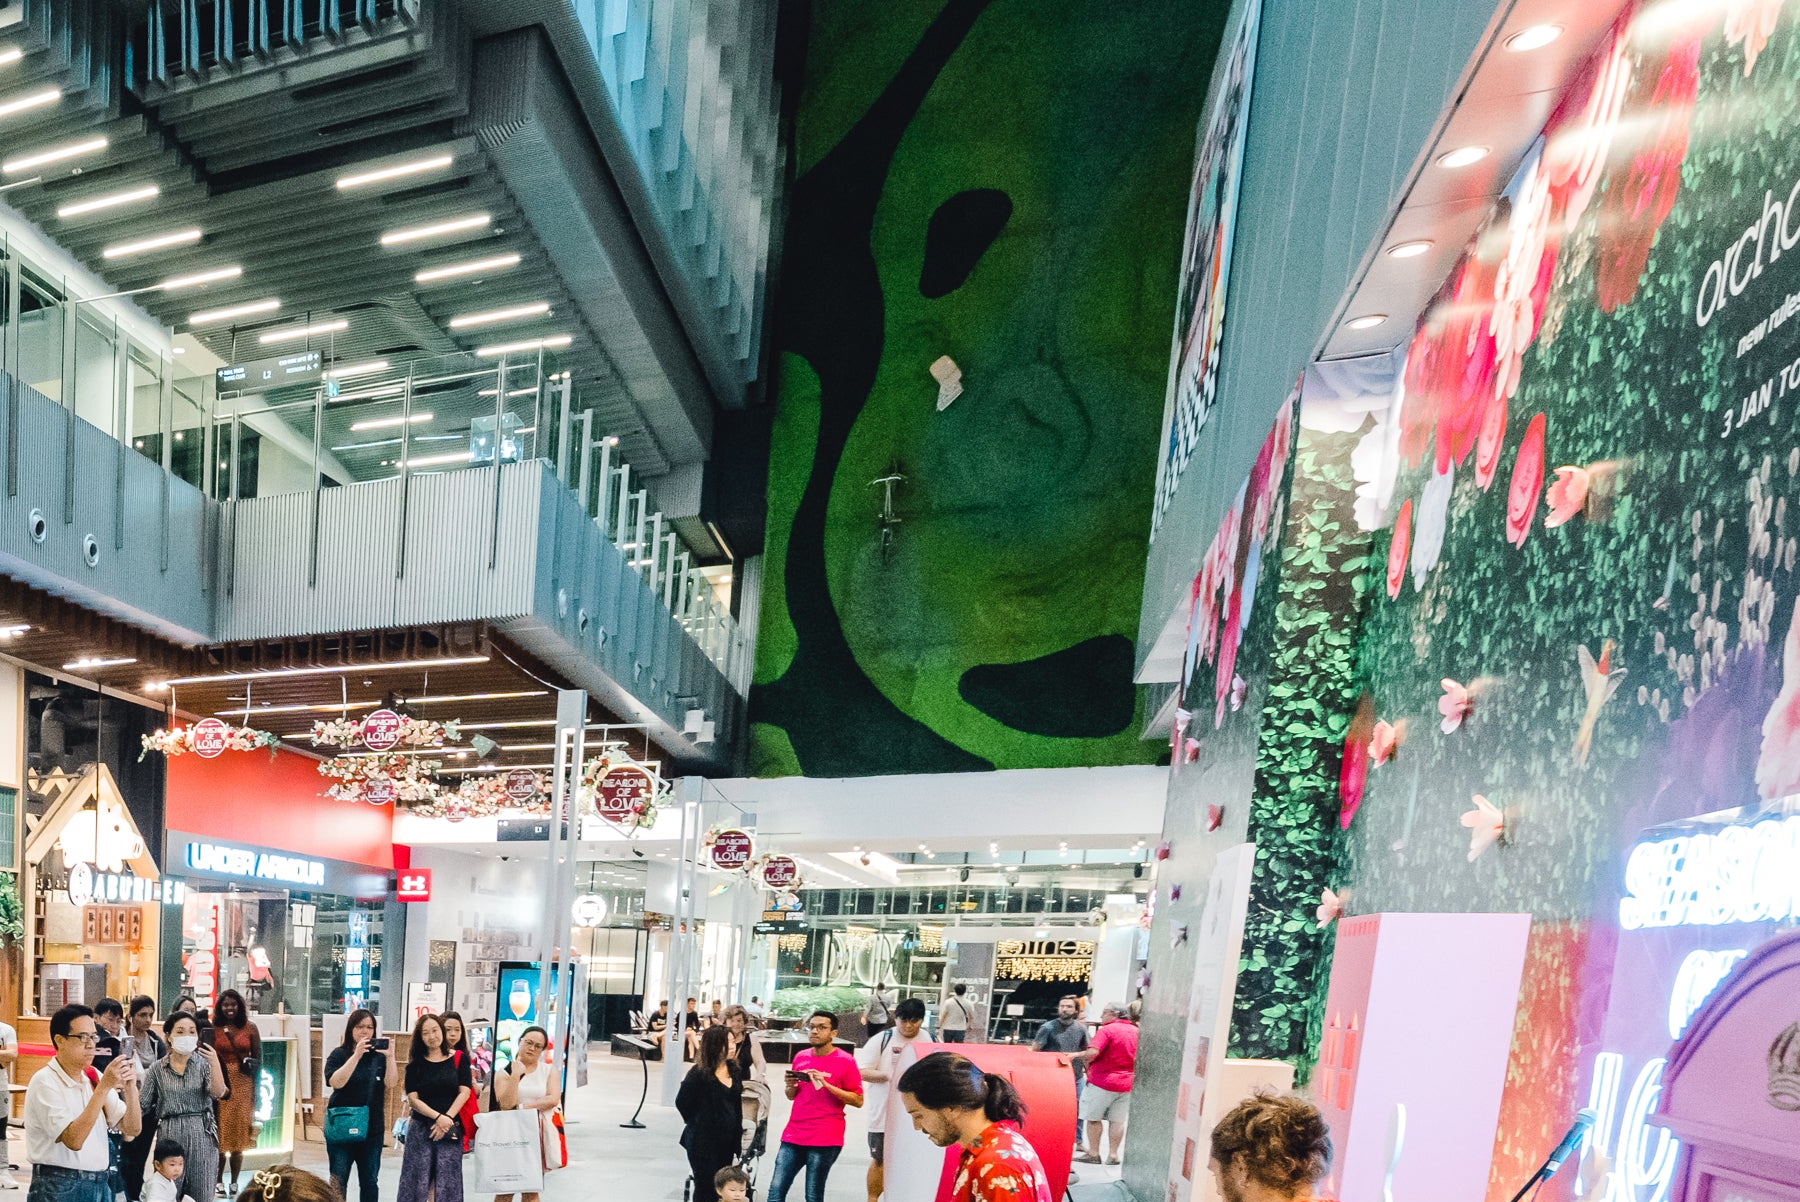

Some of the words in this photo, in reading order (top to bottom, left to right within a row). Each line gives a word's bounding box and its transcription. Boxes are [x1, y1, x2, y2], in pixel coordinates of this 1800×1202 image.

[1736, 318, 1768, 359] new
[262, 370, 272, 379] L2
[1720, 408, 1734, 438] 3
[1735, 378, 1774, 428] JAN
[367, 732, 395, 742] LOVE
[196, 739, 223, 749] LOVE
[602, 778, 647, 788] SEASONS
[508, 784, 534, 793] LOVE
[616, 788, 632, 797] OF
[368, 790, 390, 798] LOVE
[601, 797, 645, 811] LOVE
[716, 838, 749, 846] SEASONS
[715, 851, 748, 862] LOVE
[191, 842, 256, 876] UNDER
[256, 853, 325, 886] ARMOUR
[766, 872, 793, 882] LOVE
[93, 873, 186, 905] ABURI-EN
